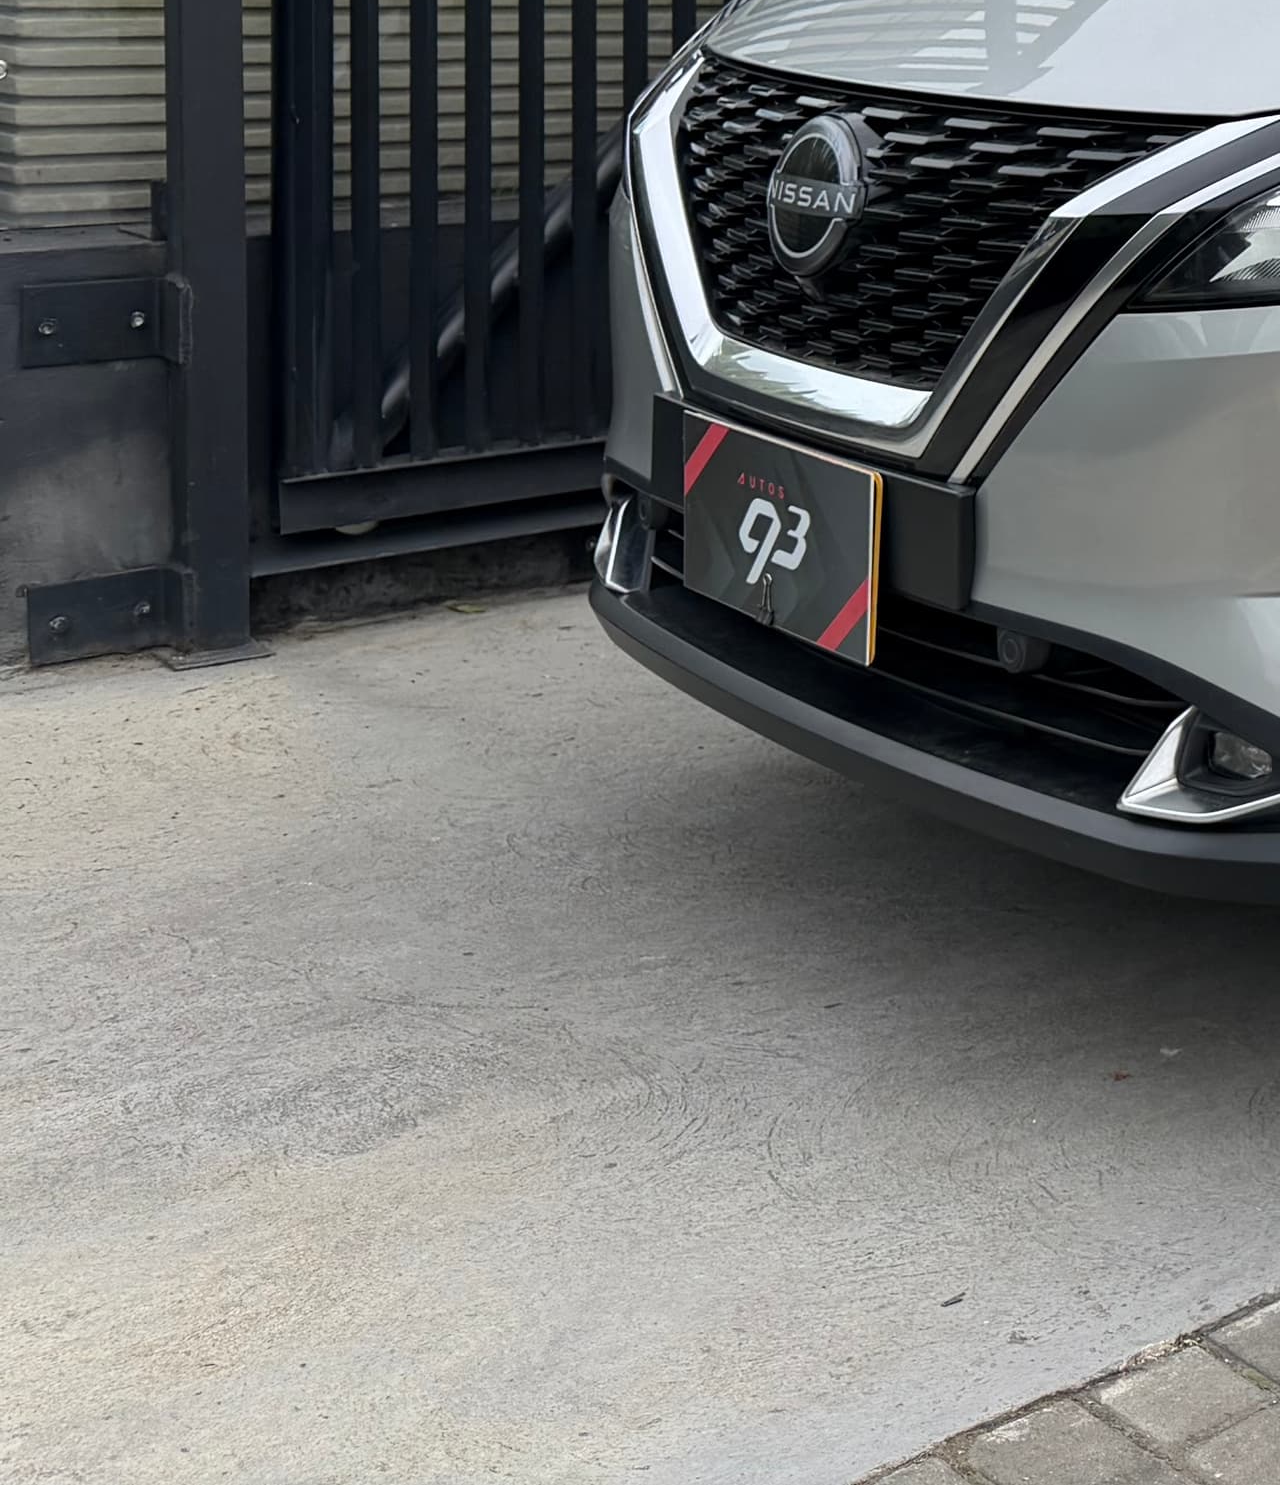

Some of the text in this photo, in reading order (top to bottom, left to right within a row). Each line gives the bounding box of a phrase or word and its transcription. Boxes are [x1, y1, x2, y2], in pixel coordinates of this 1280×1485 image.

[769, 178, 857, 215] NISSAN
[736, 471, 786, 501] AUTOS
[738, 497, 811, 585] 93
